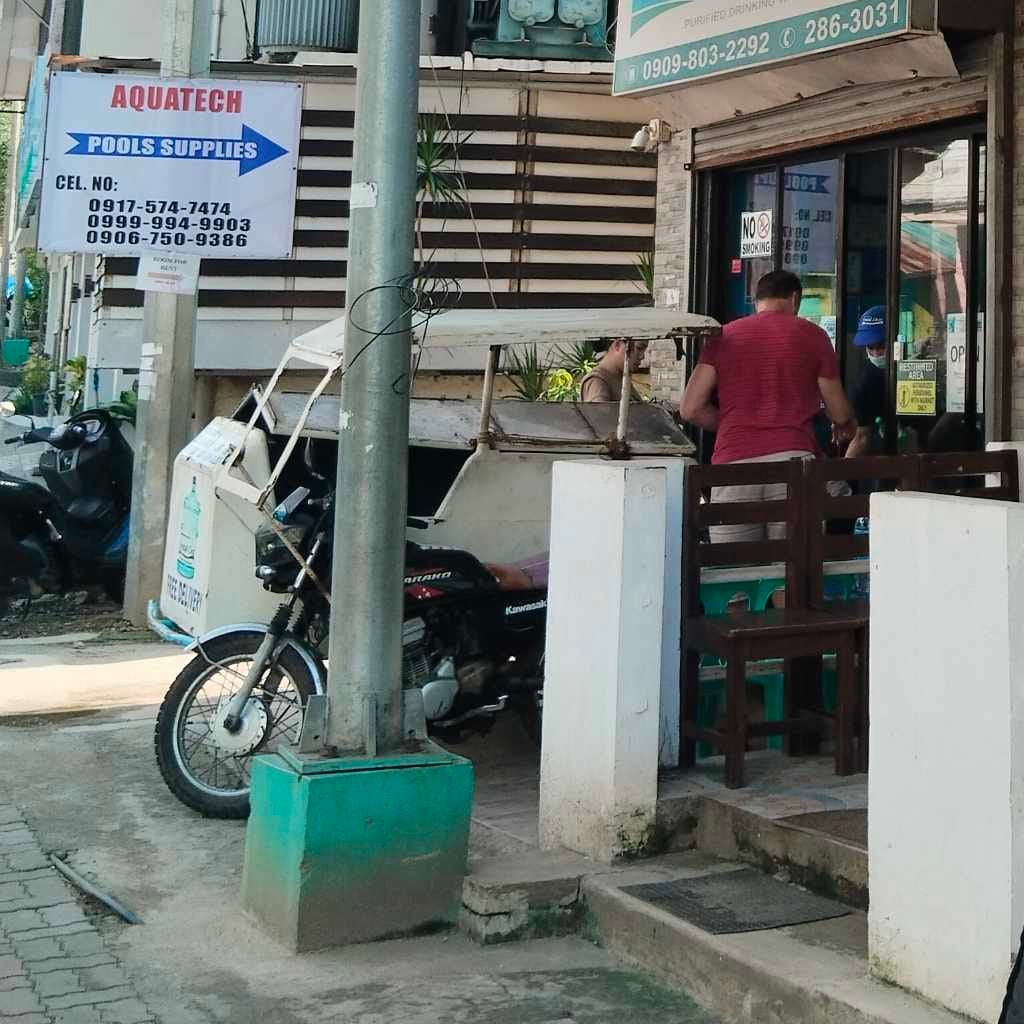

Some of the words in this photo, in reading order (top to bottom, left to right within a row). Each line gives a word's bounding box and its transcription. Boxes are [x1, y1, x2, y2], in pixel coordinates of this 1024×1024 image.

[684, 10, 724, 30] PURIFIED
[642, 32, 770, 81] 0909-803-2292
[111, 85, 243, 113] AQUATECH
[88, 136, 155, 154] POOLS
[161, 139, 257, 159] SUPPLIES
[55, 175, 87, 191] CEL.
[92, 176, 118, 192] NO:
[89, 199, 231, 215] 0917-574-7474
[88, 215, 251, 232] 0999-994-9903
[743, 216, 756, 239] NO
[86, 231, 248, 247] 0906-750-9386
[742, 240, 770, 255] SMOKING
[404, 570, 452, 583] ARAKO
[167, 574, 178, 601] FREE
[178, 581, 203, 613] DELIVERY
[505, 599, 548, 616] Kawasak
